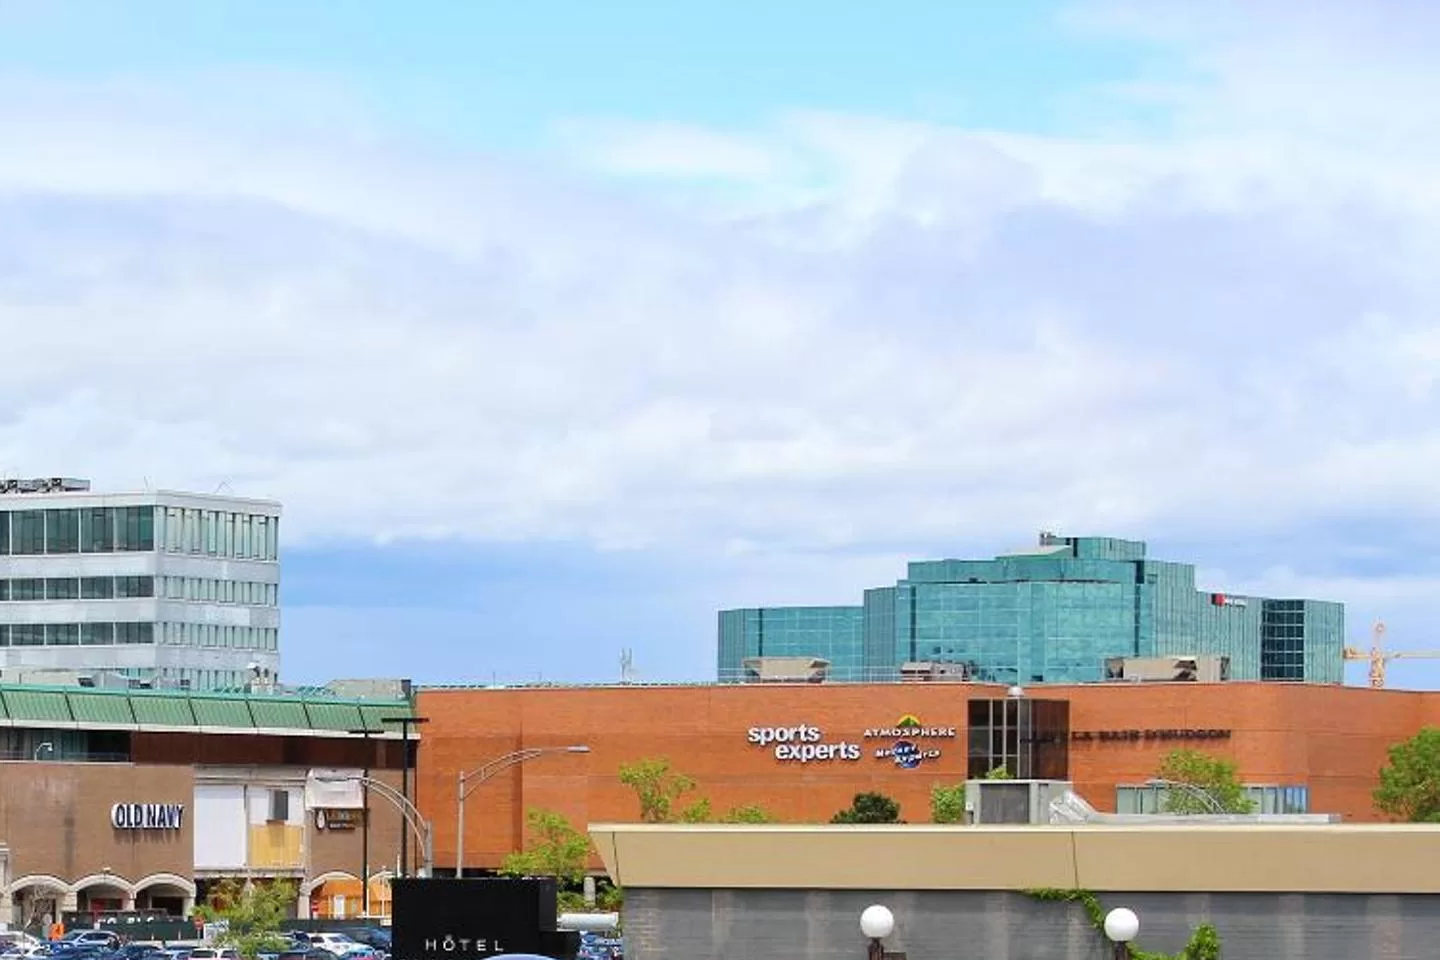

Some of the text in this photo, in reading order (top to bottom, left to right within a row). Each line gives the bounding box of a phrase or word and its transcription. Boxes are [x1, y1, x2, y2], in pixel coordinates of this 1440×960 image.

[747, 724, 821, 746] sports
[863, 727, 957, 738] ATMOSPHERE
[775, 741, 861, 763] experts
[111, 803, 184, 828] OLD NAVY
[425, 934, 504, 952] HÔTEL
